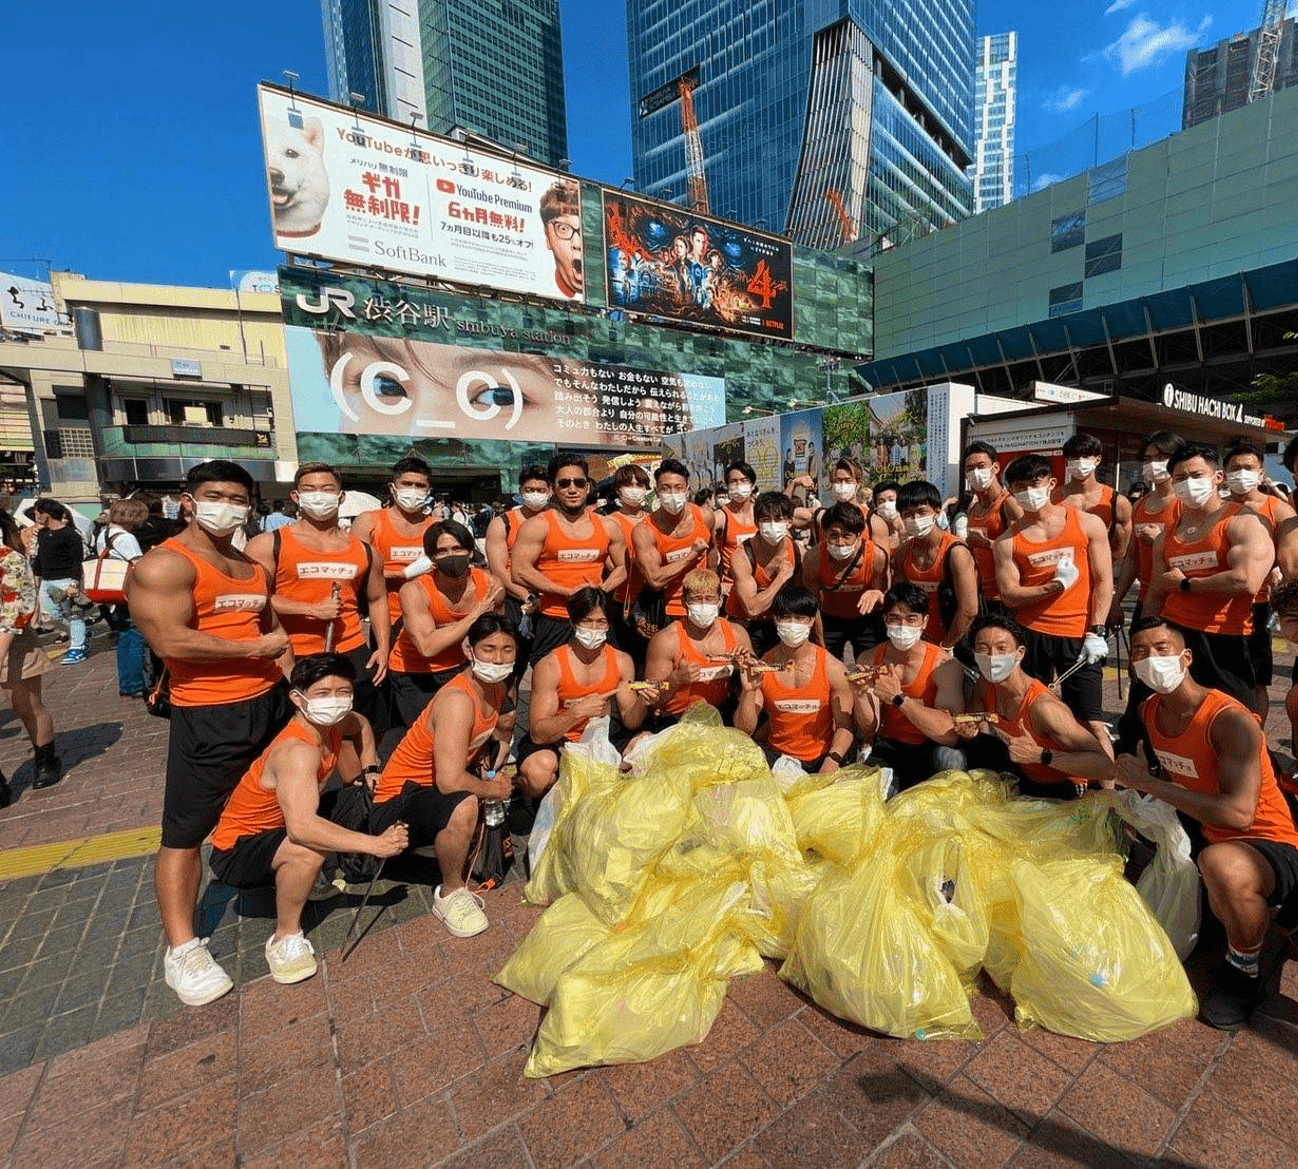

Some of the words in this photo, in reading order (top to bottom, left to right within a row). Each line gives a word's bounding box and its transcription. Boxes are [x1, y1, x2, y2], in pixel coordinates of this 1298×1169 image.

[362, 171, 401, 200] ギガ
[457, 184, 494, 205] YouTube
[494, 193, 533, 214] Premium
[343, 188, 421, 226] 無制限!
[374, 240, 447, 268] SoftBank
[296, 286, 357, 319] JR
[363, 296, 452, 330] 渋谷駅
[457, 319, 519, 339] shibuya
[523, 329, 571, 345] station
[1173, 389, 1198, 413] SHIBU
[1198, 396, 1221, 418] HACHI
[1221, 402, 1237, 421] BOX
[299, 566, 354, 575] エコマッチョ
